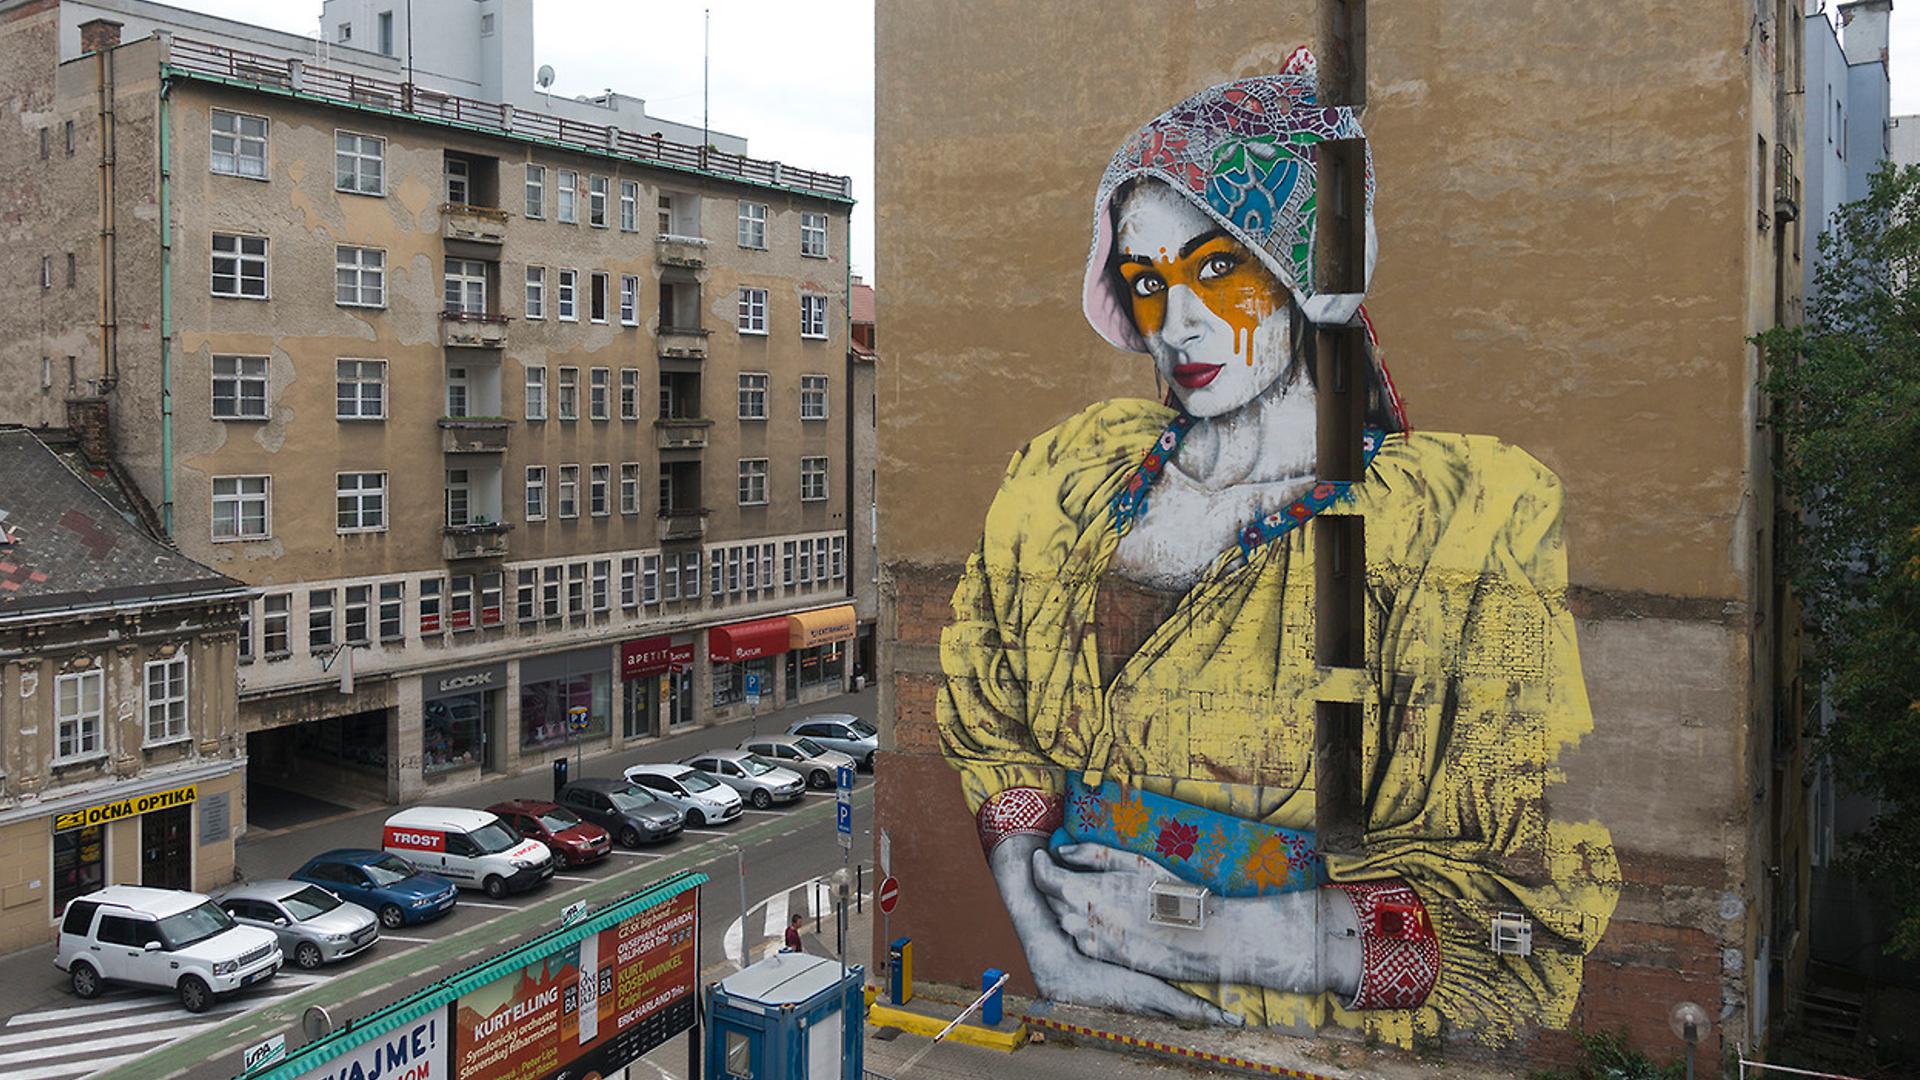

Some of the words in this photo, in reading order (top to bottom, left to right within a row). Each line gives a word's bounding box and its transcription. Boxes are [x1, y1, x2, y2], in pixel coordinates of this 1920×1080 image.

[89, 799, 132, 823] OČNÁ
[138, 788, 195, 811] OPTIKA
[840, 806, 848, 823] P
[393, 832, 439, 847] TROST
[618, 960, 644, 982] KURT
[474, 1009, 512, 1041] KURT
[513, 986, 558, 1022] ELLING
